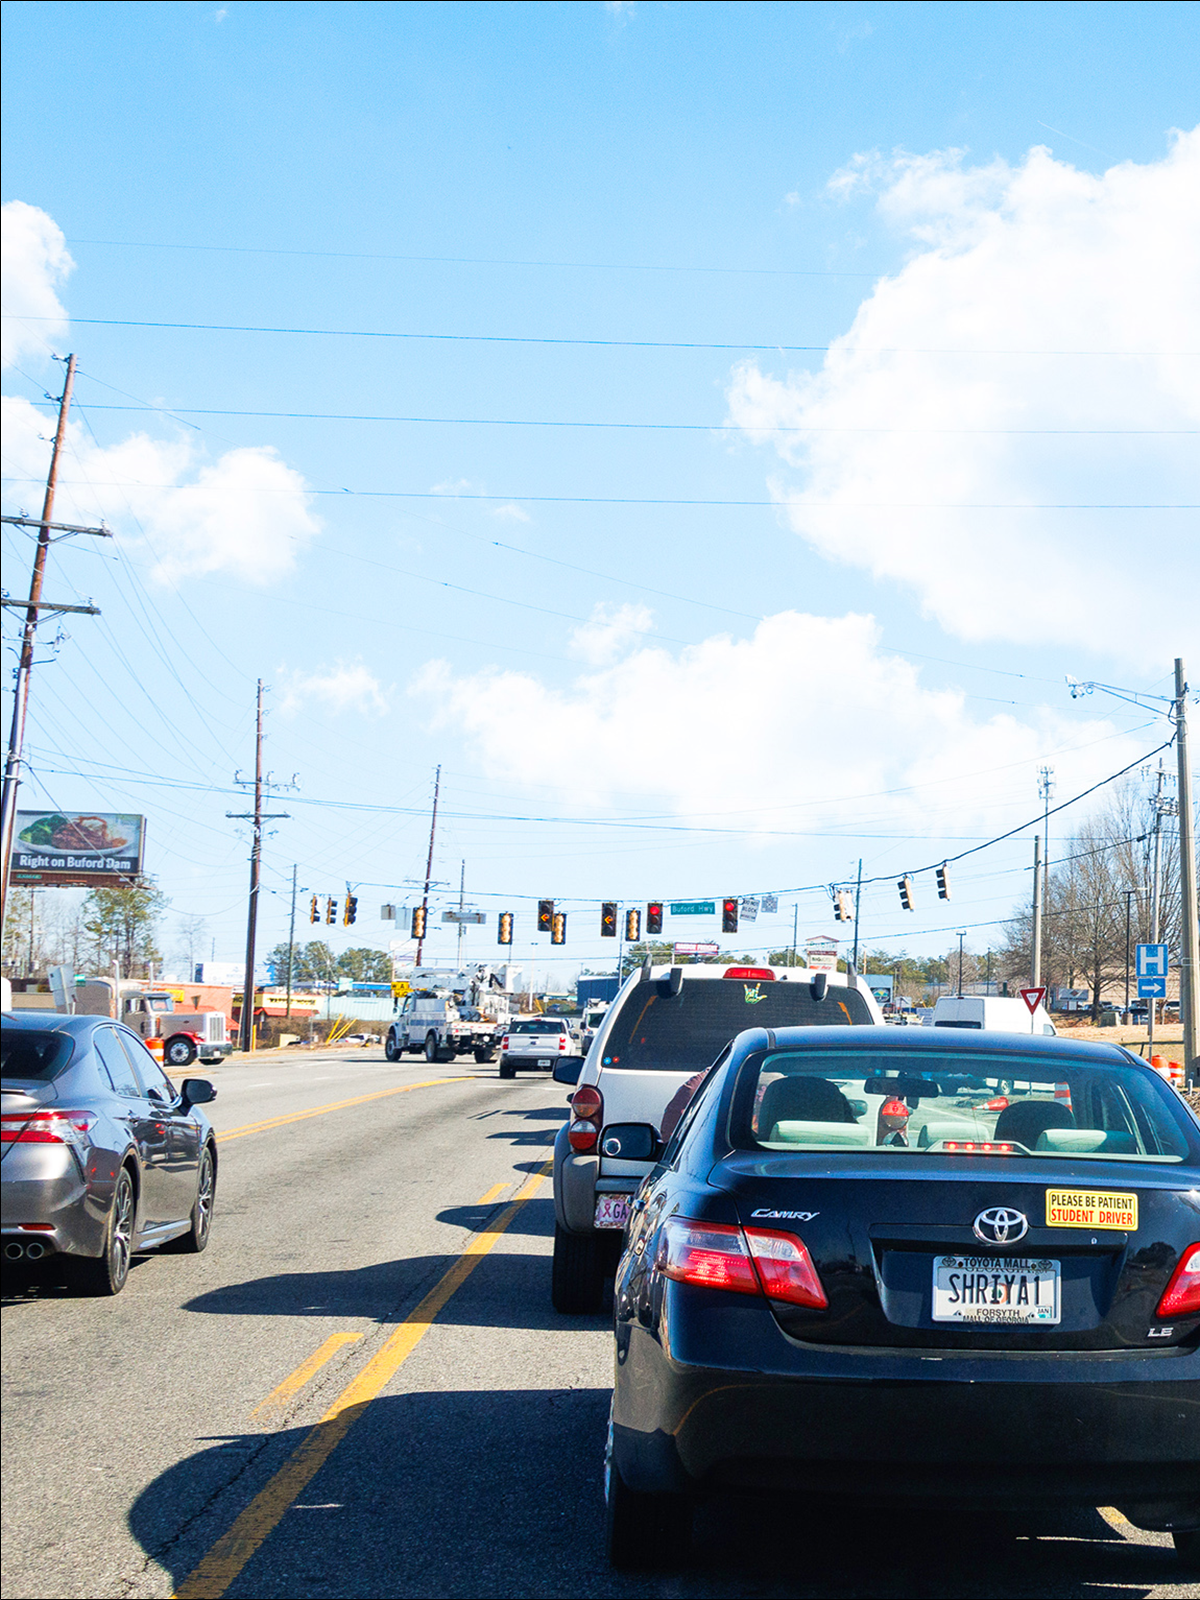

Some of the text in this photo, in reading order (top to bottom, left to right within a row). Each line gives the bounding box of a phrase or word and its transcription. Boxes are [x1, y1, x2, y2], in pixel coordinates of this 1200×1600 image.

[19, 855, 131, 869] Right on Buford Dam
[699, 905, 713, 913] Hwy
[1140, 946, 1164, 974] H
[1051, 1195, 1132, 1209] PLEASE BE PATIENT
[751, 1208, 820, 1221] CAMRY
[1051, 1209, 1133, 1225] STUDENT DRIVER
[964, 1258, 1030, 1268] TOYOTA MALL
[948, 1273, 1040, 1305] SHRIYA1
[977, 1308, 1020, 1316] FORSYTH
[1148, 1327, 1174, 1337] LE
